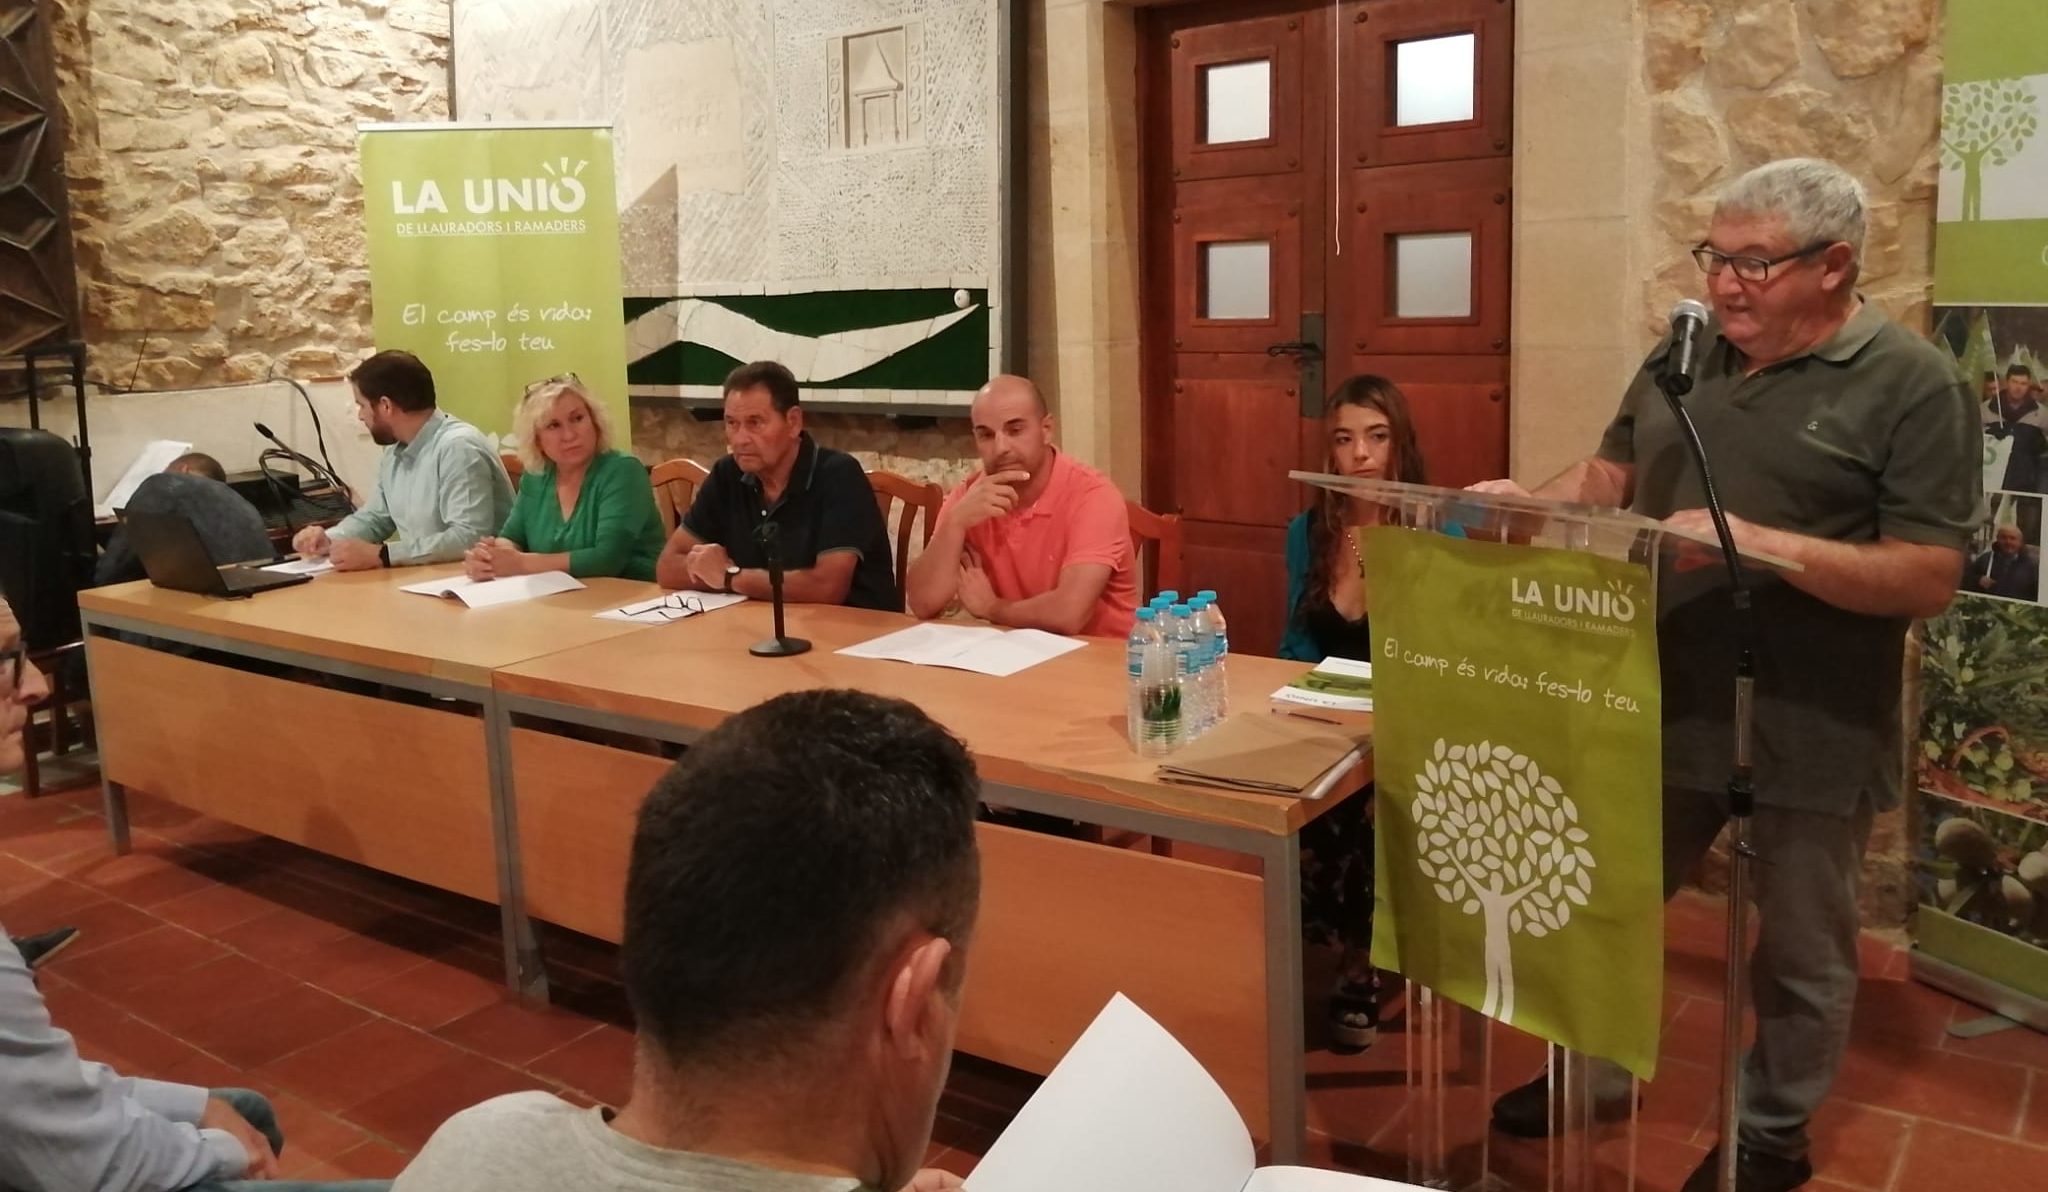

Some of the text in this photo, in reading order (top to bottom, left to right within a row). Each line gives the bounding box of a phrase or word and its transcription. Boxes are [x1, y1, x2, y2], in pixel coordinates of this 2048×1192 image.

[391, 179, 449, 214] LA
[396, 223, 413, 235] DE
[417, 221, 503, 234] LLAURADORS
[514, 219, 586, 233] RAMADERS
[402, 303, 425, 325] El
[436, 309, 496, 328] camp
[507, 302, 530, 322] és
[445, 330, 555, 352] fes-lo teu
[1511, 577, 1544, 607] LA
[1384, 637, 1399, 659] El
[1404, 650, 1449, 677] camp
[1457, 656, 1476, 677] és
[1535, 671, 1592, 703] fes-lo
[1603, 688, 1640, 713] teu
